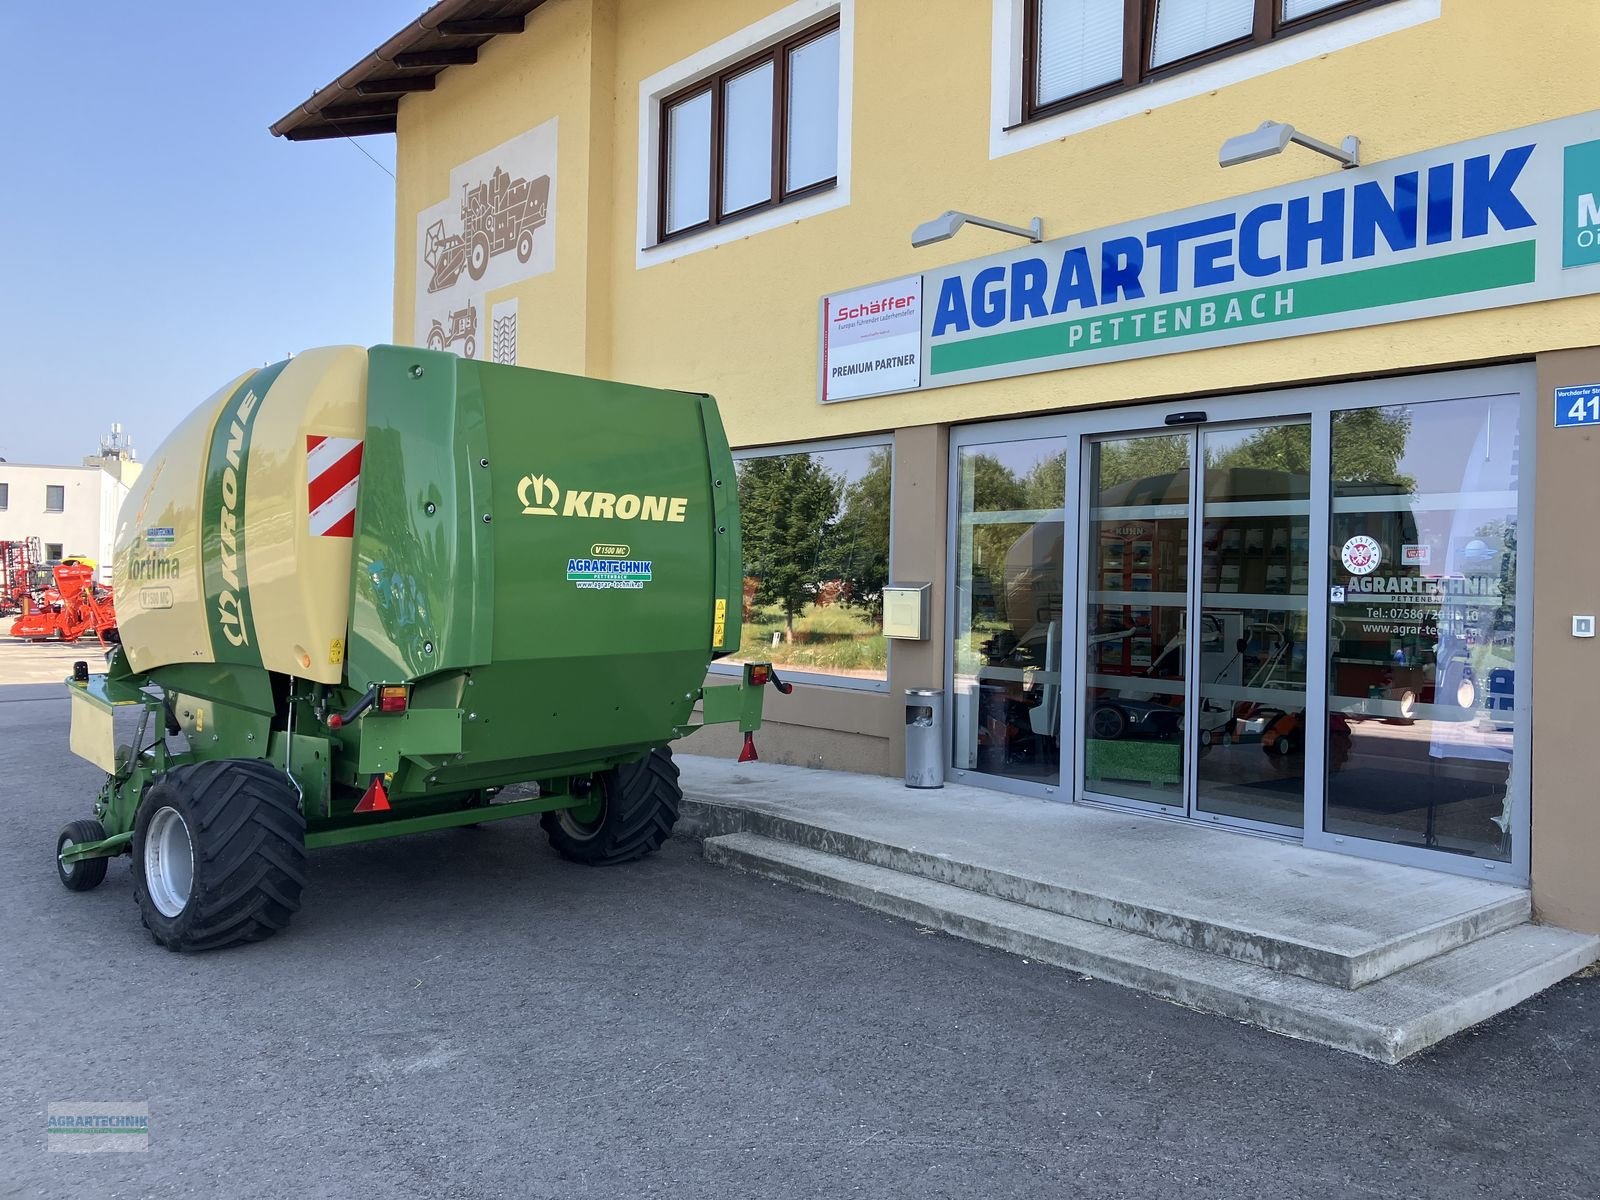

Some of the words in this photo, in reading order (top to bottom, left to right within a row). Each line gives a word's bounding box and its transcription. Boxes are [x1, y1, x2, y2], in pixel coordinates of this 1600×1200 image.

[932, 143, 1537, 337] AGRARTECHNIK
[834, 295, 916, 322] Schäffer
[1068, 288, 1295, 348] PETTENBACH
[832, 361, 873, 378] PREMIUM
[875, 353, 915, 371] PARTNER
[1567, 395, 1600, 421] 41
[220, 389, 258, 592] KRONE
[562, 490, 688, 523] KRONE
[1115, 526, 1144, 536] KUHN
[595, 546, 602, 554] V
[615, 547, 626, 555] MC
[1344, 536, 1377, 552] MEISTER
[568, 559, 651, 573] AGRARTECHNIK
[1347, 576, 1502, 595] AGRARTECHNIK
[1366, 607, 1388, 618] Tel.:
